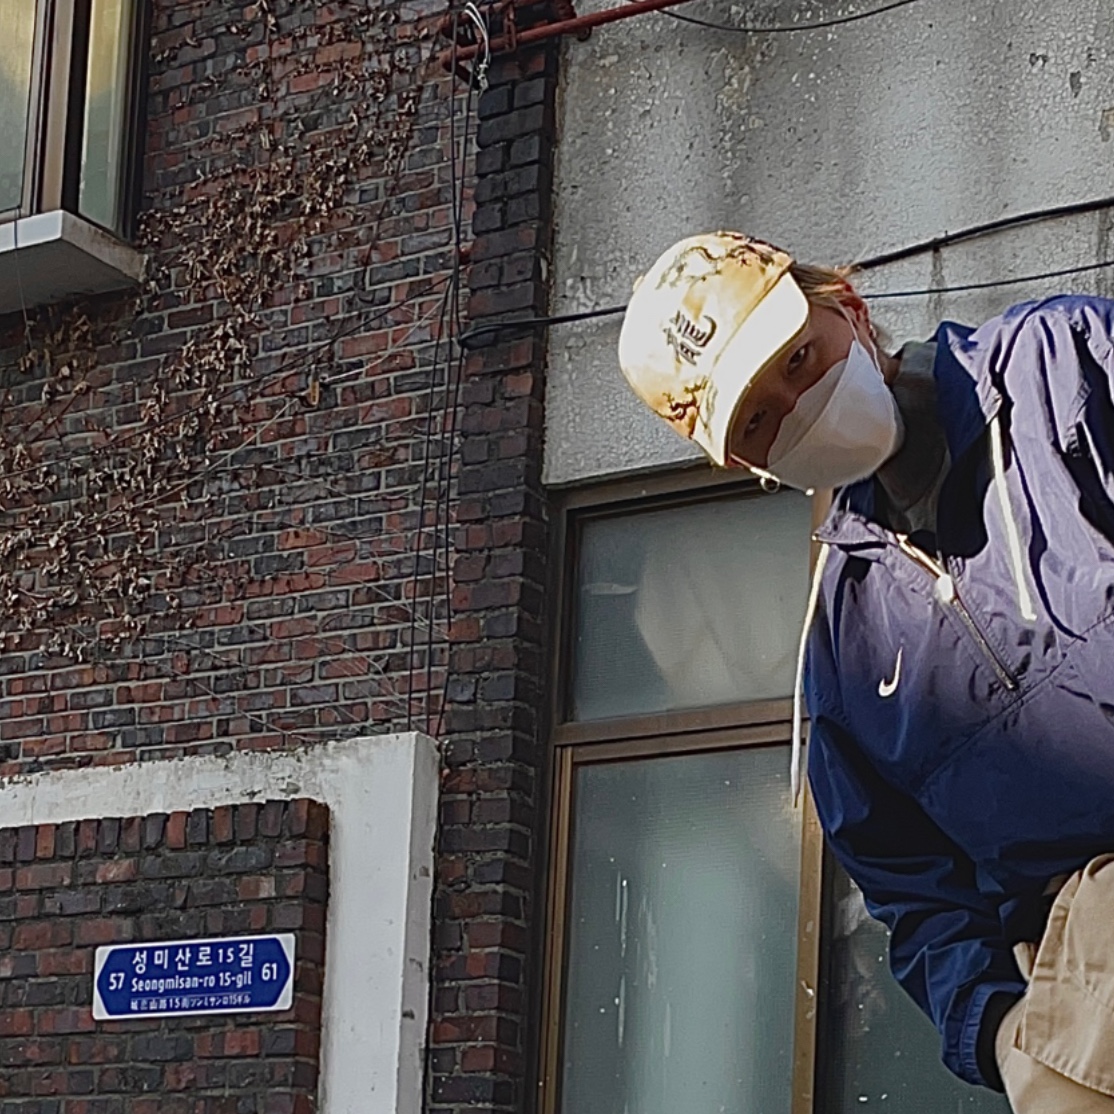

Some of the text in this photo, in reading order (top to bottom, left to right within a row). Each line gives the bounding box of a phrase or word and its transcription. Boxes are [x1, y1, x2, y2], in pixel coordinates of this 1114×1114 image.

[108, 972, 125, 991] 57
[131, 970, 252, 994] Seongmisan-ro 15-gil
[261, 962, 278, 982] 61
